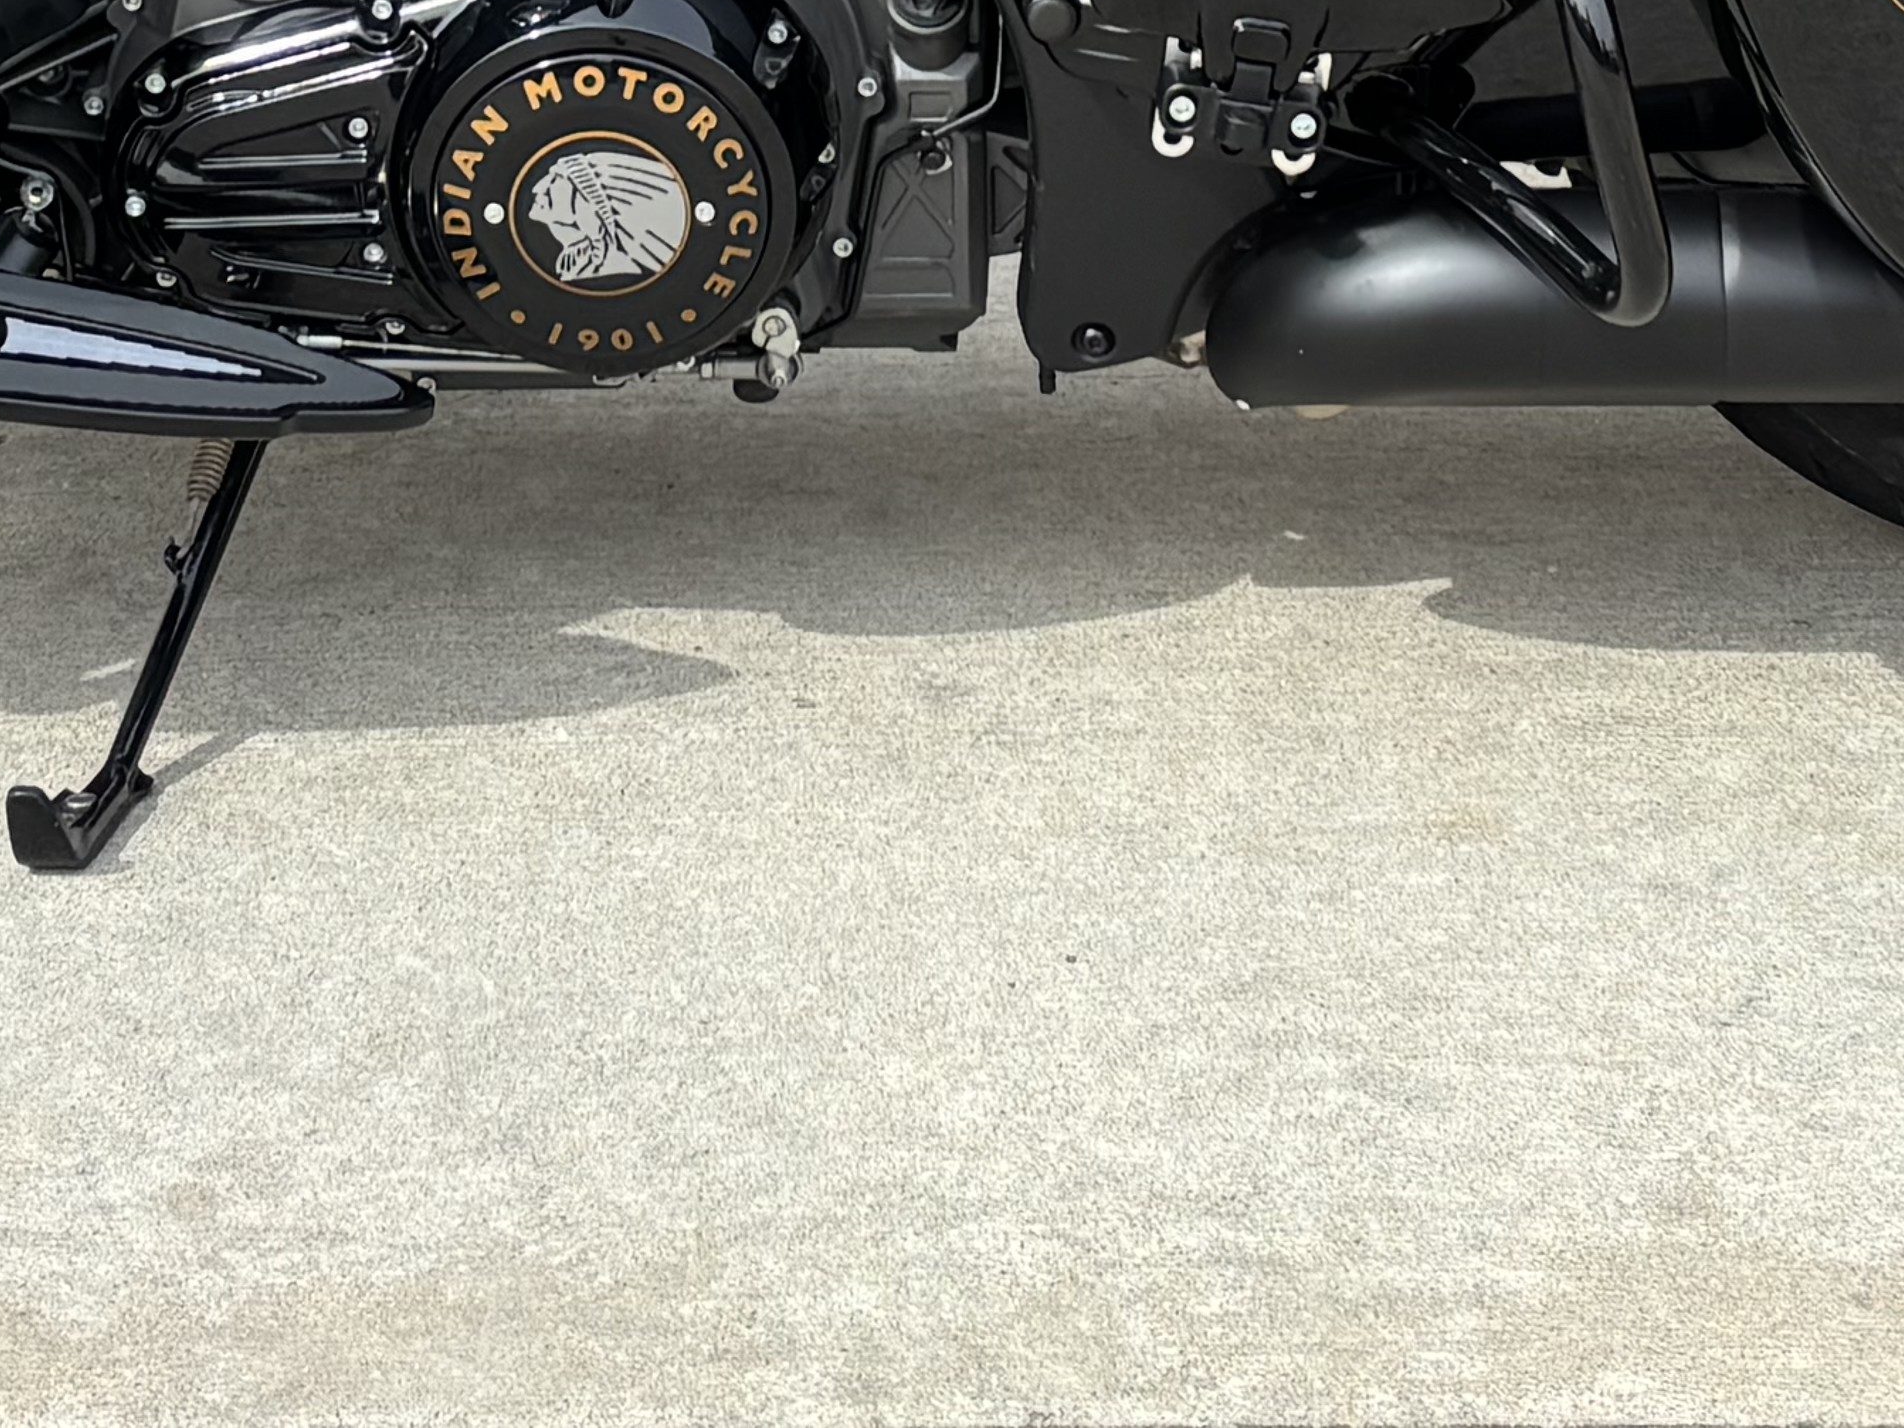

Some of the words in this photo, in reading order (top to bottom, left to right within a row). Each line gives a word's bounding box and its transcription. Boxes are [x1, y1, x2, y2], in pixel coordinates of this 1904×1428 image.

[442, 104, 509, 301] INDIAN
[523, 66, 759, 299] MOTORCYCLE
[548, 320, 663, 351] 1901
